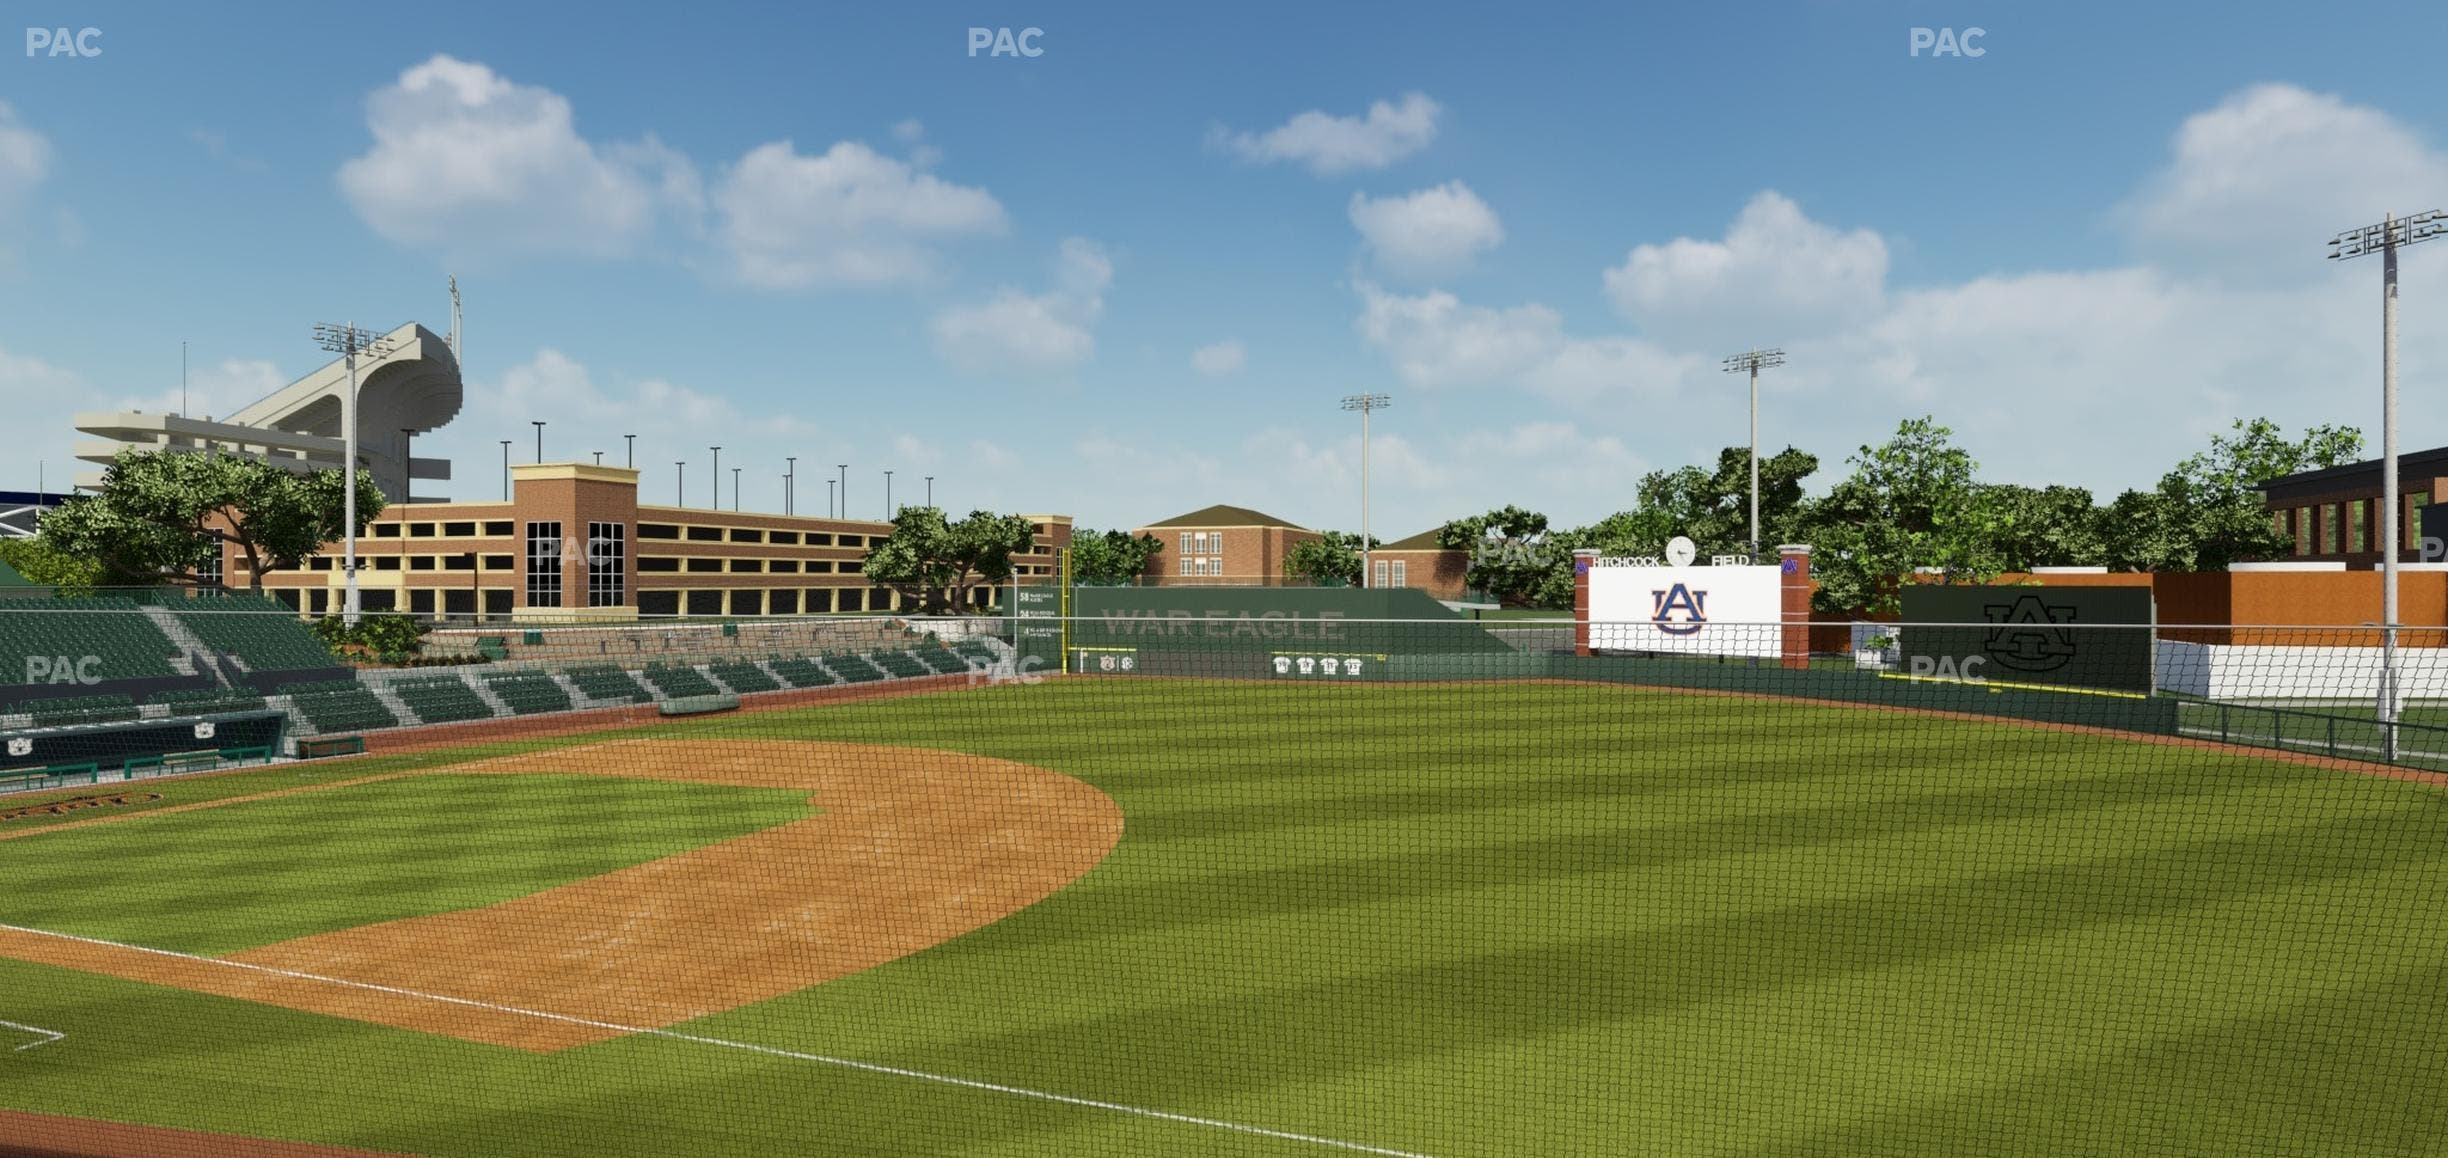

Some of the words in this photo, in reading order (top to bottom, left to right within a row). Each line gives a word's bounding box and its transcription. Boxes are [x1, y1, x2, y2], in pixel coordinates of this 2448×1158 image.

[1593, 556, 1660, 567] HITCHCOCK
[1712, 555, 1749, 566] FIELD
[1100, 609, 1193, 635] WAR
[1204, 610, 1346, 640] EAGLE
